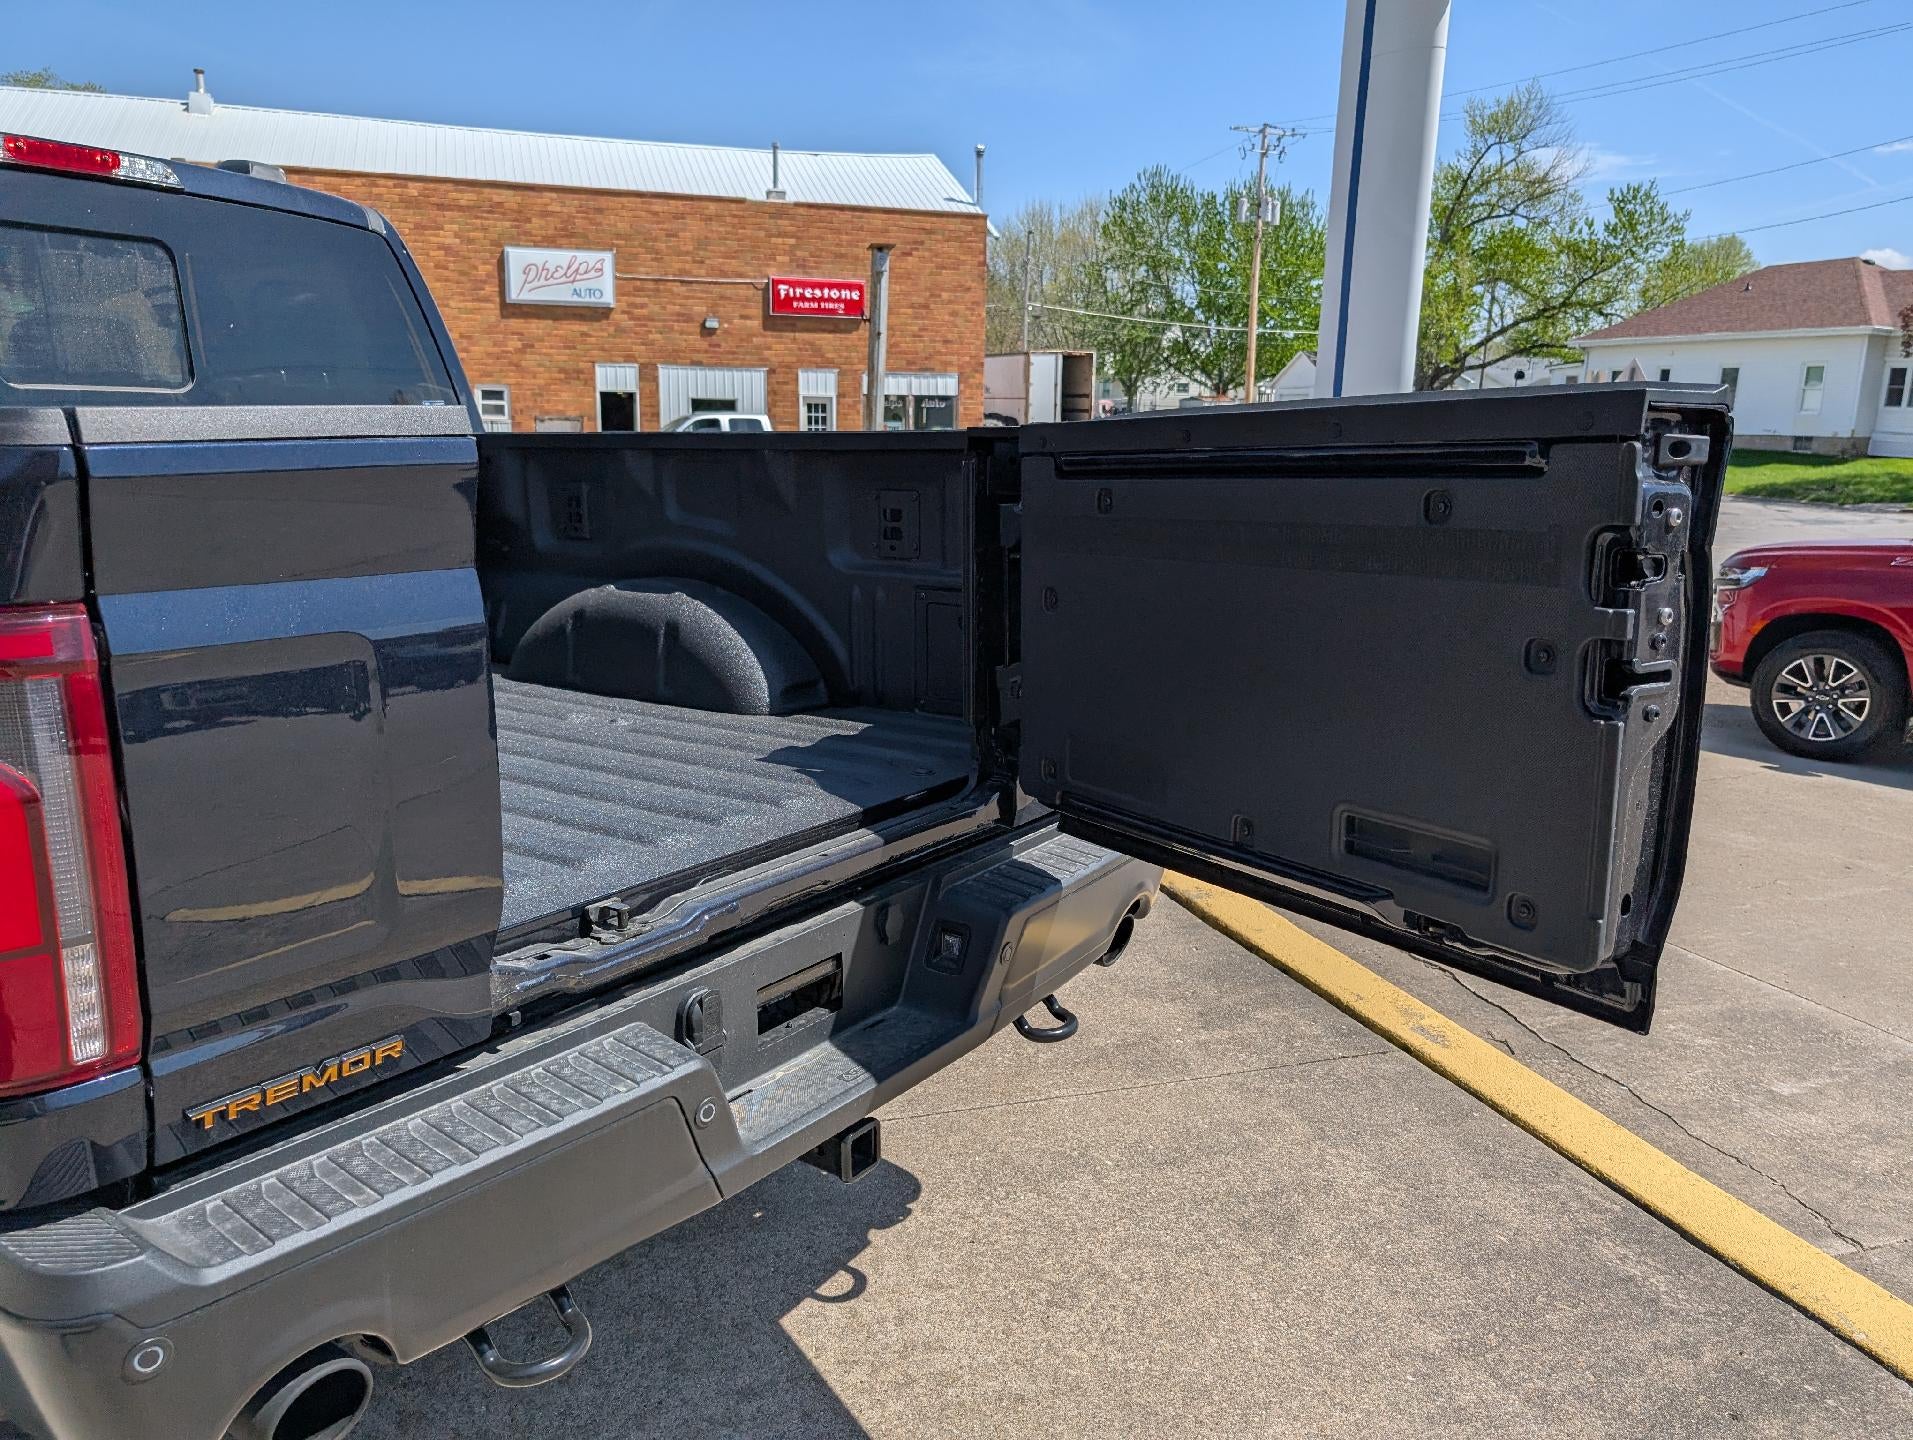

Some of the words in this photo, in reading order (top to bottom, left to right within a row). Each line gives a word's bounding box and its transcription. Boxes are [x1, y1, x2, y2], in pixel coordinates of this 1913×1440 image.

[516, 254, 605, 298] Phelps
[571, 287, 604, 299] AUTO
[777, 283, 860, 301] Firestone
[792, 301, 819, 309] FARM
[820, 302, 845, 310] TIRES
[185, 1034, 406, 1130] TREMOR
